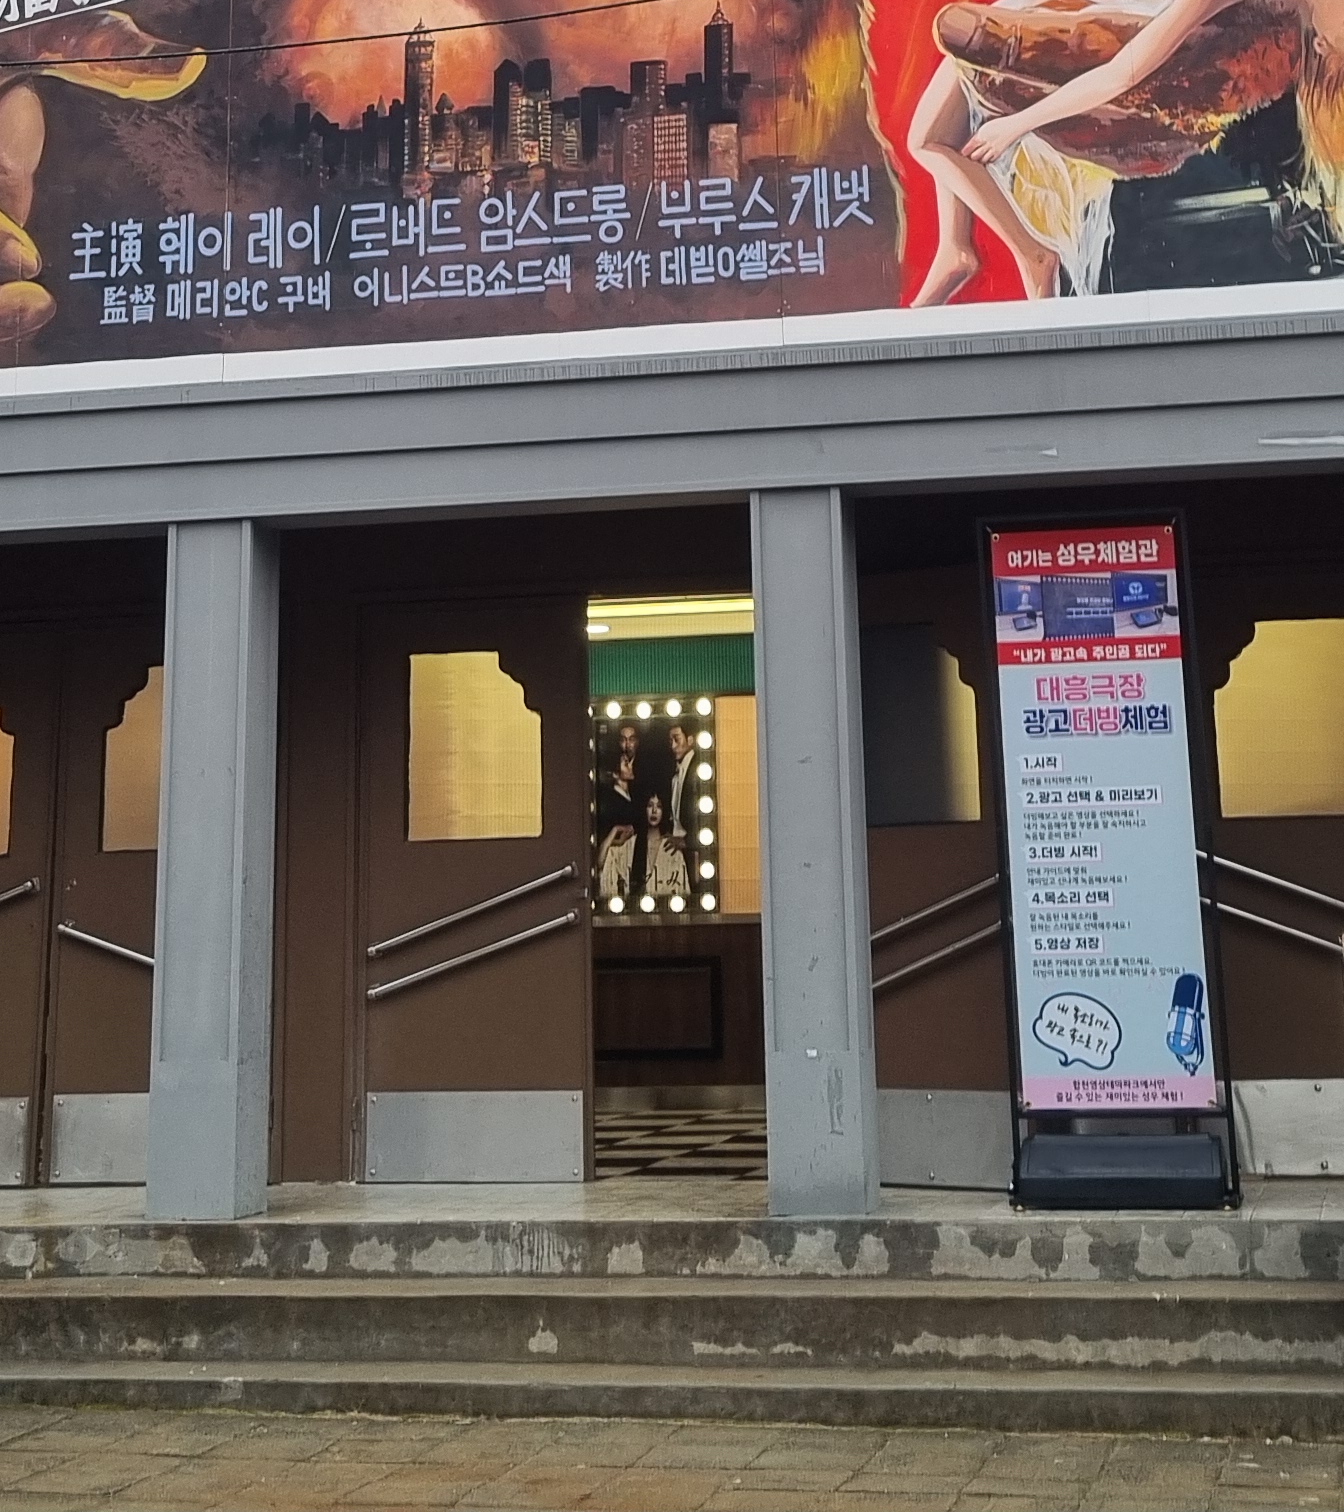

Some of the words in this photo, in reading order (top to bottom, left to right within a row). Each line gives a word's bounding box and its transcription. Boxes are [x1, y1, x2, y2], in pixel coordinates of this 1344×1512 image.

[69, 218, 143, 280] 主演
[1007, 548, 1053, 568] 여기는
[1057, 538, 1158, 566] 성우체험관
[1035, 673, 1145, 703] 대흥극장
[1022, 703, 1171, 737] 광고더빙체험
[1026, 791, 1062, 805] 2.광고
[1067, 789, 1091, 803] 선택
[1095, 791, 1105, 803] &
[1109, 787, 1158, 803] 미리보기
[1029, 846, 1065, 860] 3.더빙
[1070, 845, 1098, 858] 시작!
[1031, 890, 1081, 905] 4.목소리
[1085, 890, 1110, 904] 선택
[1075, 936, 1099, 949] 저장
